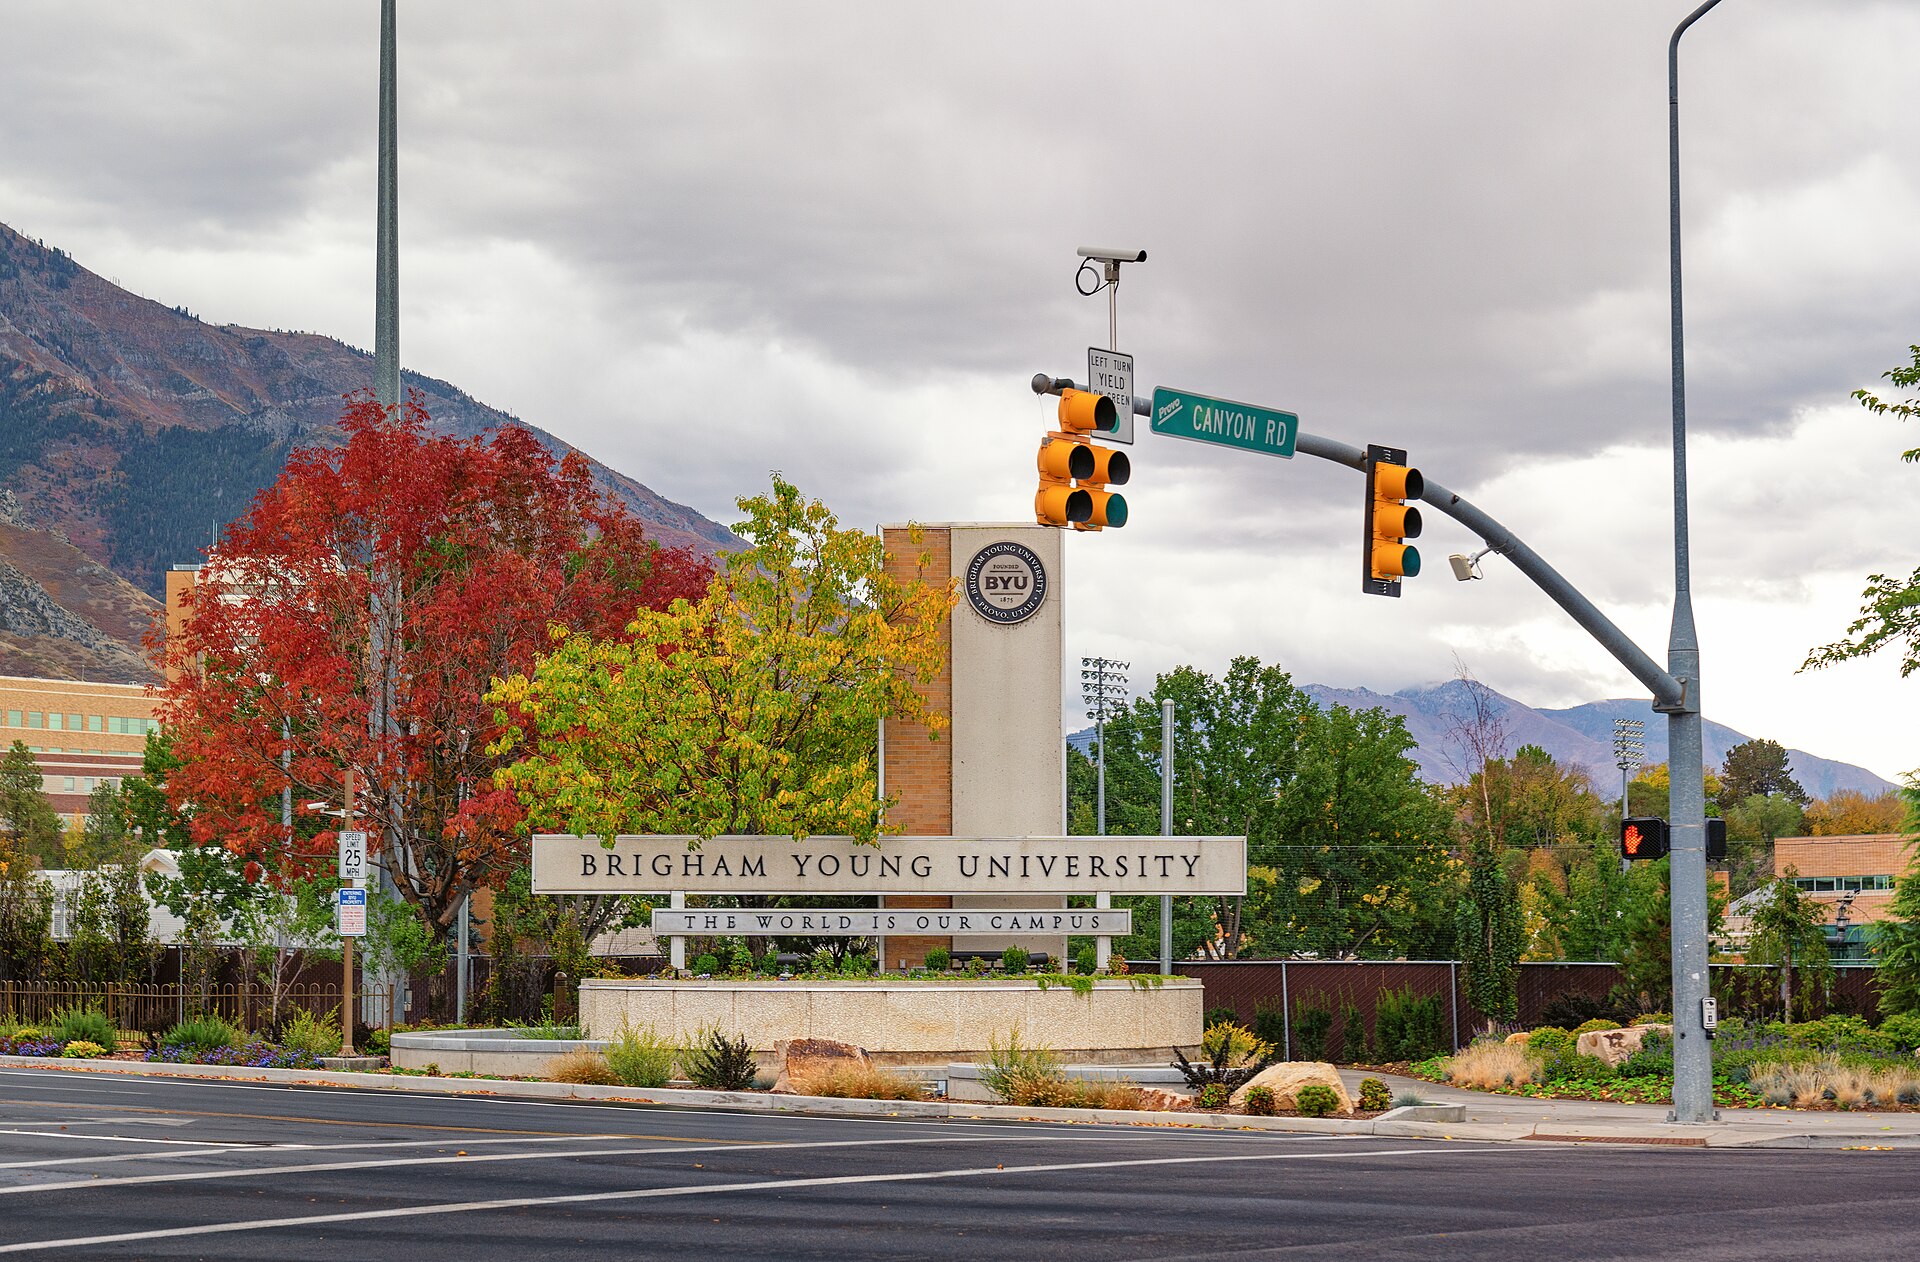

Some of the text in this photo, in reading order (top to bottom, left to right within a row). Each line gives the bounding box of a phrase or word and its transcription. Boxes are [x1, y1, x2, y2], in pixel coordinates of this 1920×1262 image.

[1091, 355, 1131, 372] LEFT TURN
[1098, 372, 1125, 390] YIELD
[1158, 398, 1180, 419] Provo
[1193, 404, 1287, 447] CANYON RD
[969, 545, 1044, 595] BRIGHAM YOUNG UNIVERSITY
[985, 576, 1028, 590] BYU
[1011, 601, 1035, 618] UTAH
[345, 833, 361, 841] SPEED
[345, 849, 361, 867] 25
[580, 854, 1201, 878] BRIGHAM YOUNG UNIVERSITY
[346, 867, 360, 877] MPH
[684, 915, 1100, 930] THE WORLD IS OUR CAMPUS
